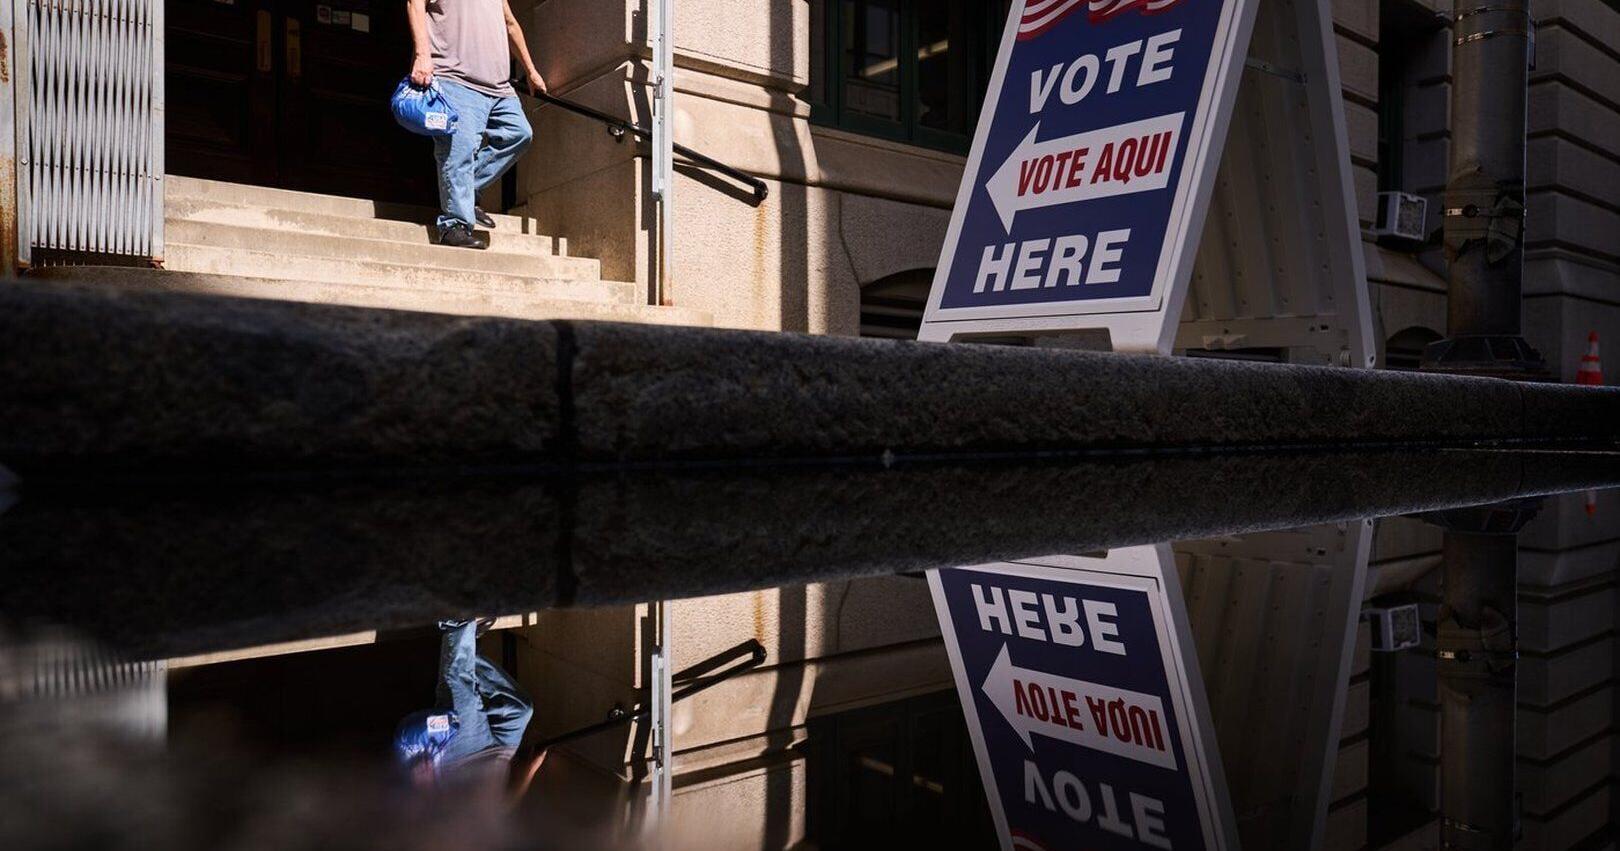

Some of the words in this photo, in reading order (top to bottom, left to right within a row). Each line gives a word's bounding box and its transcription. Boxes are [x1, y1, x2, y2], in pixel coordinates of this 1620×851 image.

[1029, 28, 1182, 114] VOTE
[1018, 147, 1089, 197] VOTE
[1091, 131, 1173, 185] AQUI
[972, 228, 1131, 294] HERE
